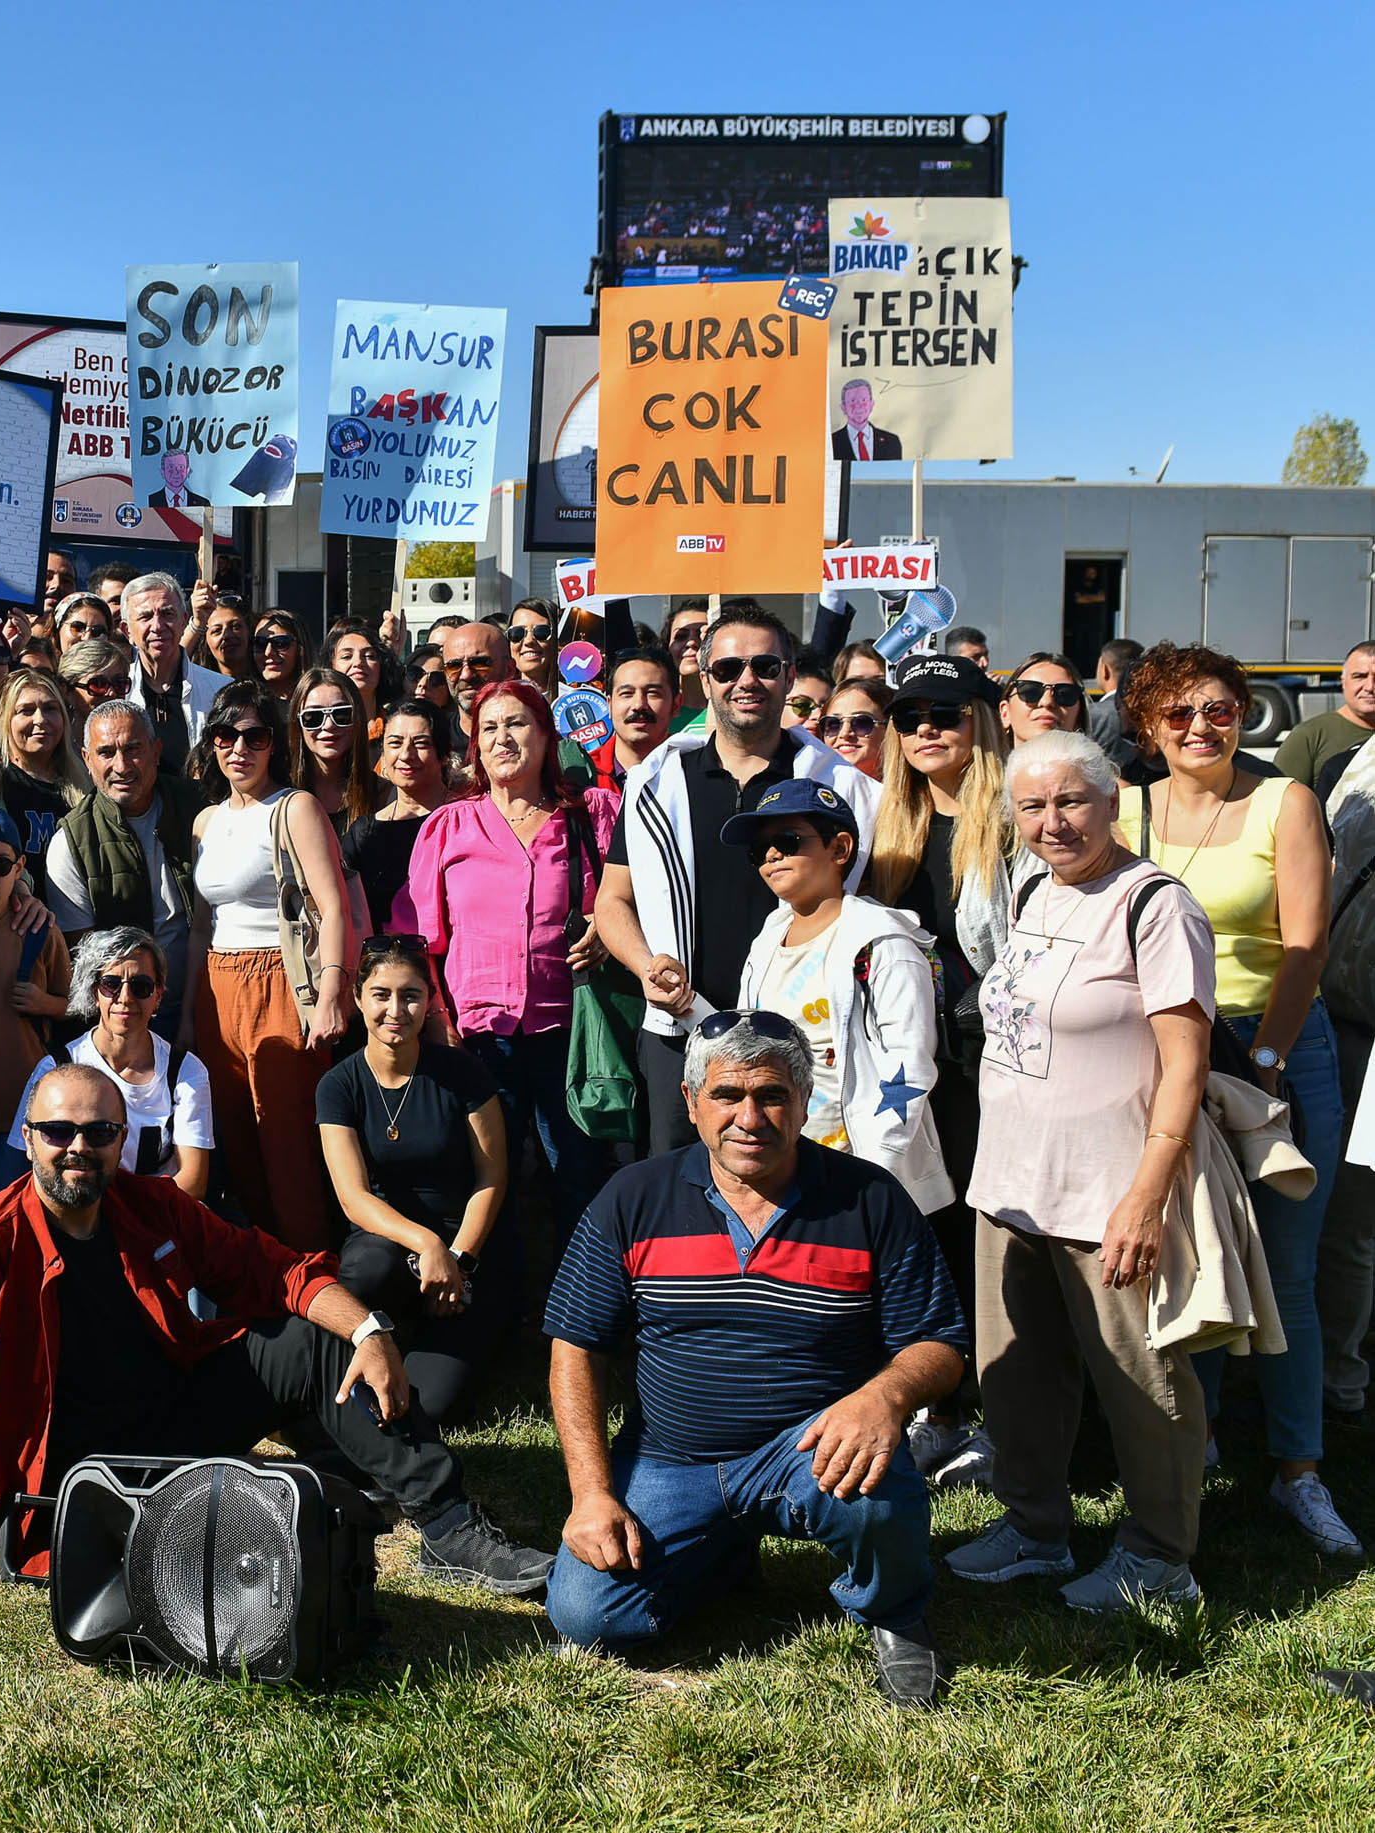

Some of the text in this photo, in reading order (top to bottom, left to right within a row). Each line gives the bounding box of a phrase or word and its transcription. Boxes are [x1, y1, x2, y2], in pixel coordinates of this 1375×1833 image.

[640, 116, 956, 141] ANKARA BÜYÜKŞEHİR BELEDİYESİ
[833, 244, 908, 274] BAKAP
[935, 247, 1004, 281] ÇIK
[795, 288, 827, 308] REC
[853, 282, 978, 327] TEPİN
[136, 280, 274, 350] SON
[342, 323, 496, 371] MANSUR
[627, 313, 799, 366] BURASI
[840, 323, 997, 368] İSTERSEN
[74, 347, 114, 373] Ben
[137, 362, 285, 401] DİNOZOR
[349, 385, 498, 429] BAŞKAN
[67, 432, 114, 458] ABB
[140, 415, 269, 457] BÜKÜCÜ
[341, 440, 365, 455] BASIN
[371, 428, 478, 462] YOLUMUZ,
[329, 458, 474, 489] BASIN DAİRESİ
[606, 454, 788, 507] CANLI
[342, 494, 480, 527] YURDUMUZ
[558, 509, 592, 520] HABER
[679, 538, 706, 550] ABB
[925, 660, 957, 671] MORE,
[933, 667, 959, 679] LESS
